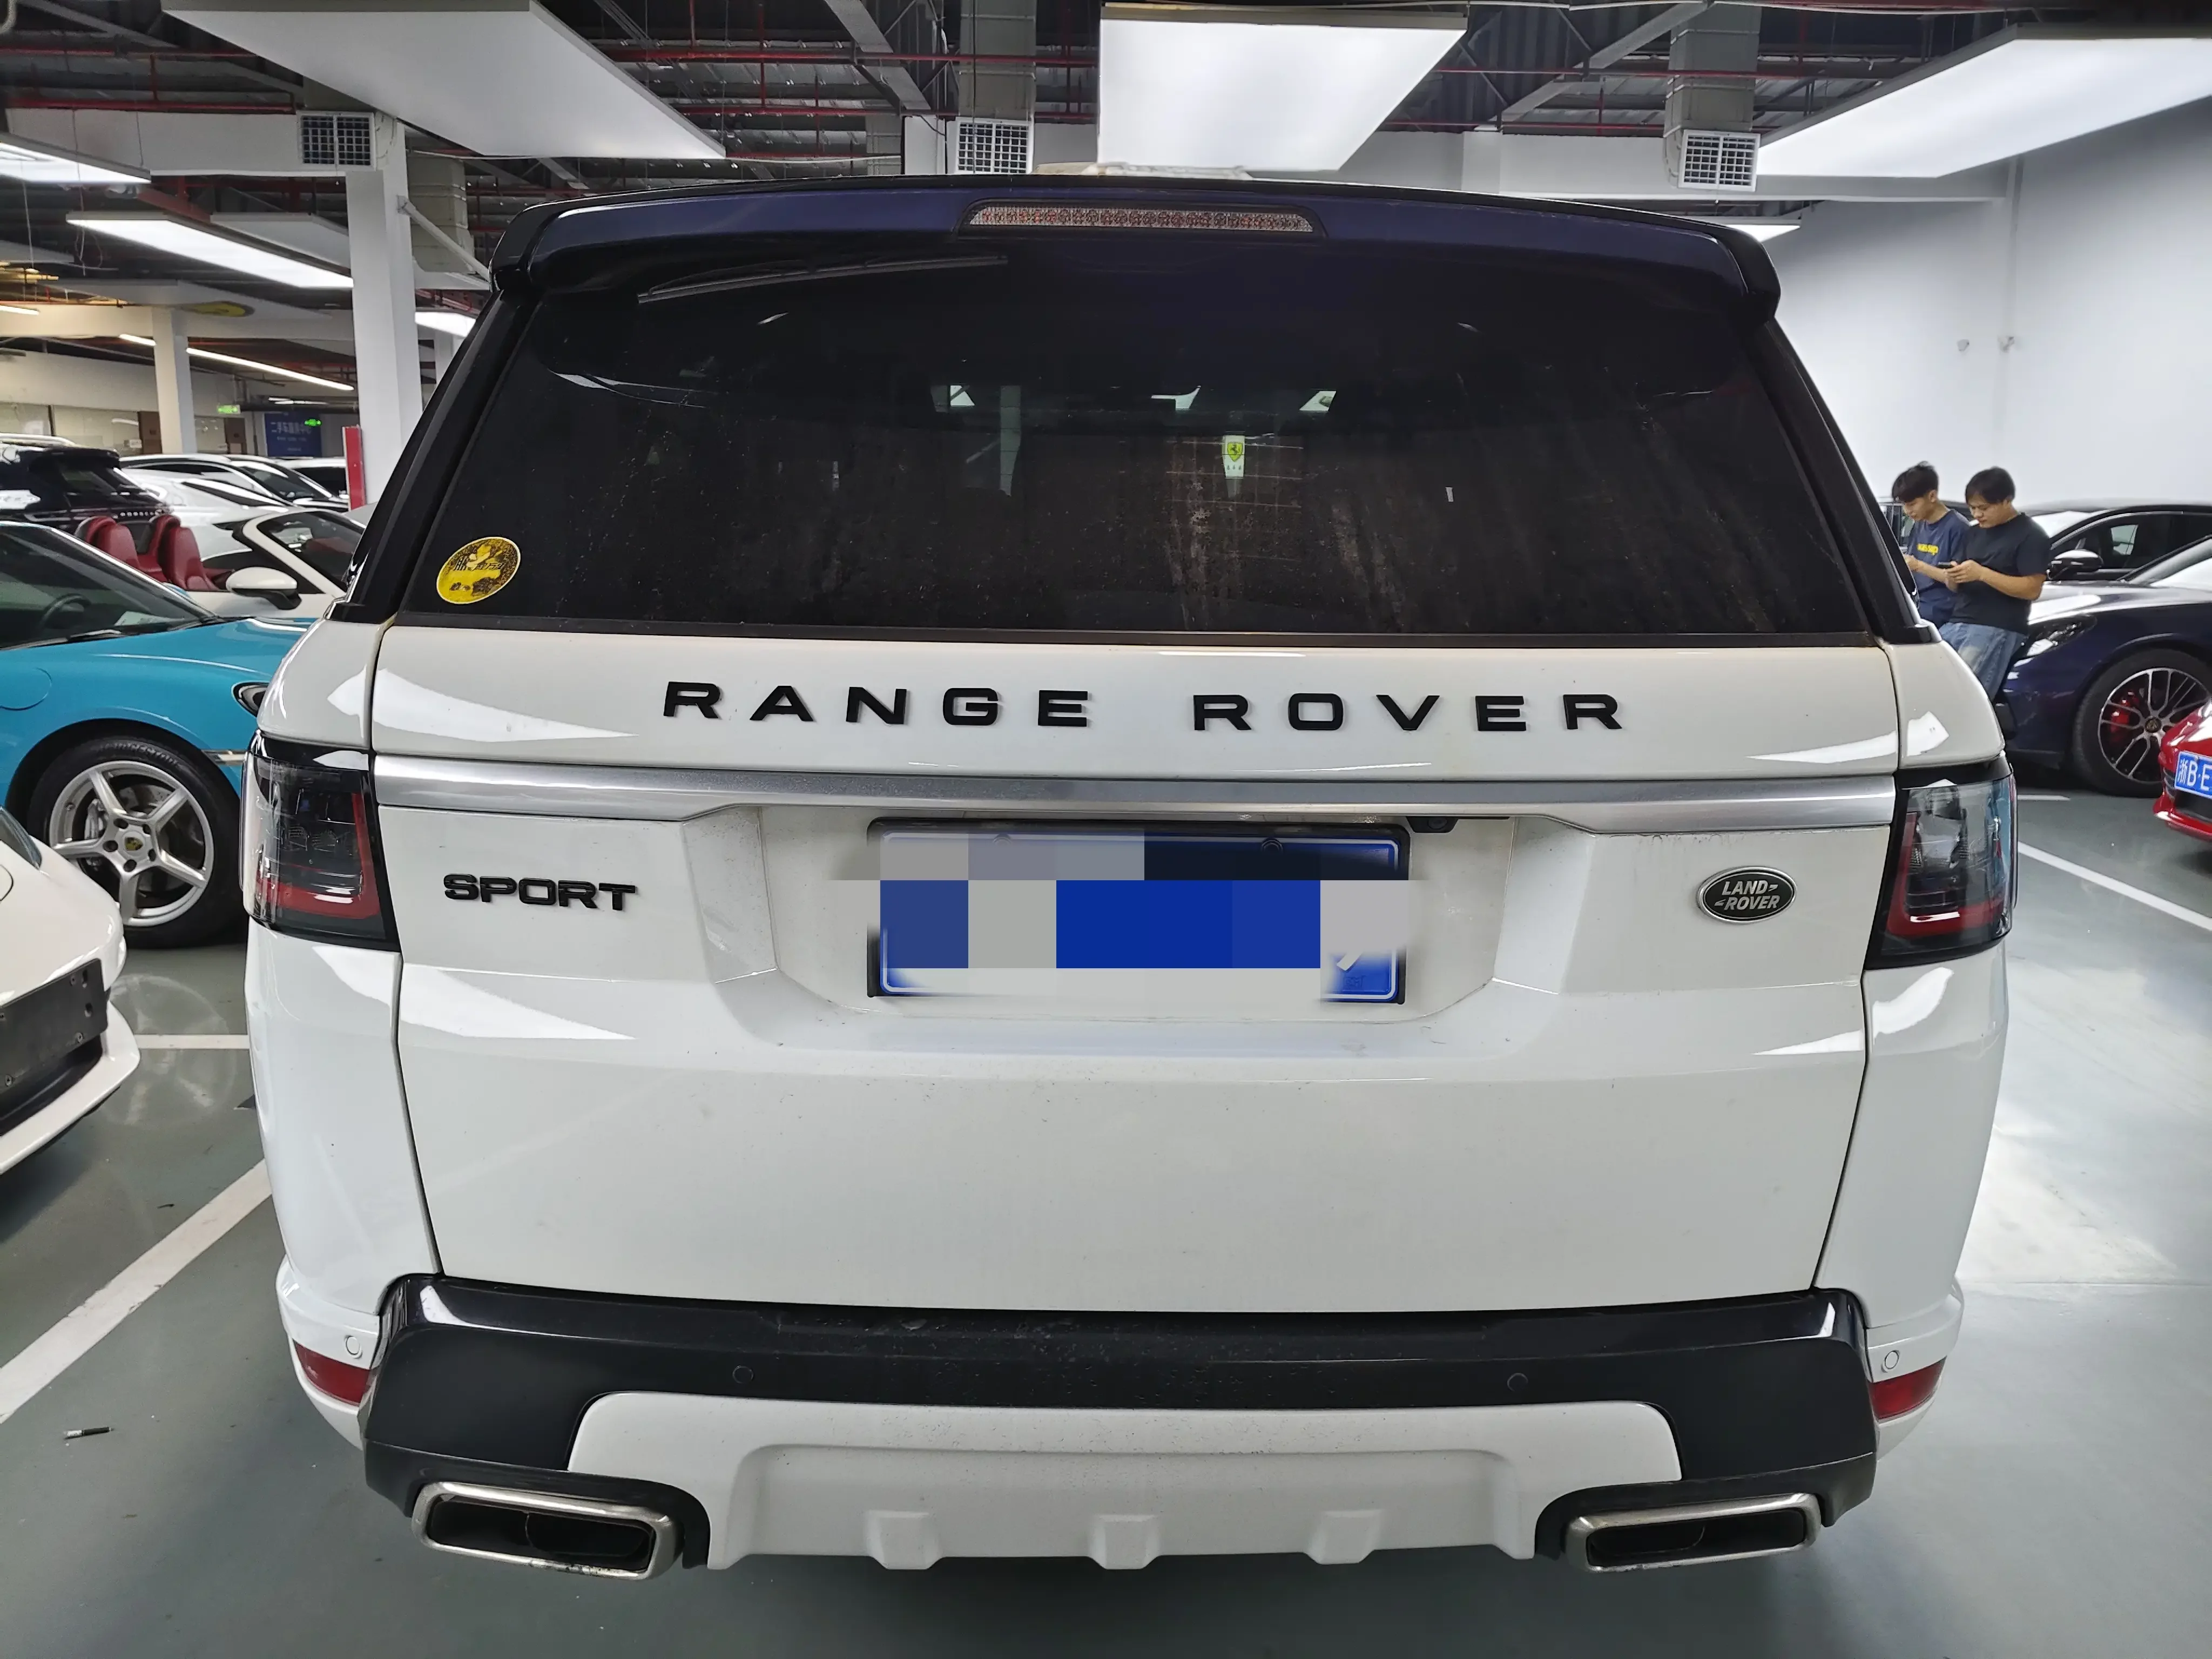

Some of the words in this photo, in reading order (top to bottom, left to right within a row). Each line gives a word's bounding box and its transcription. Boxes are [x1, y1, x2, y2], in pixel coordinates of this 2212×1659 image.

[663, 681, 1089, 727] RANGE
[1193, 693, 1622, 732] ROVER
[443, 874, 636, 911] SPORT
[1722, 880, 1769, 895] LAND
[1724, 895, 1781, 911] ROVER
